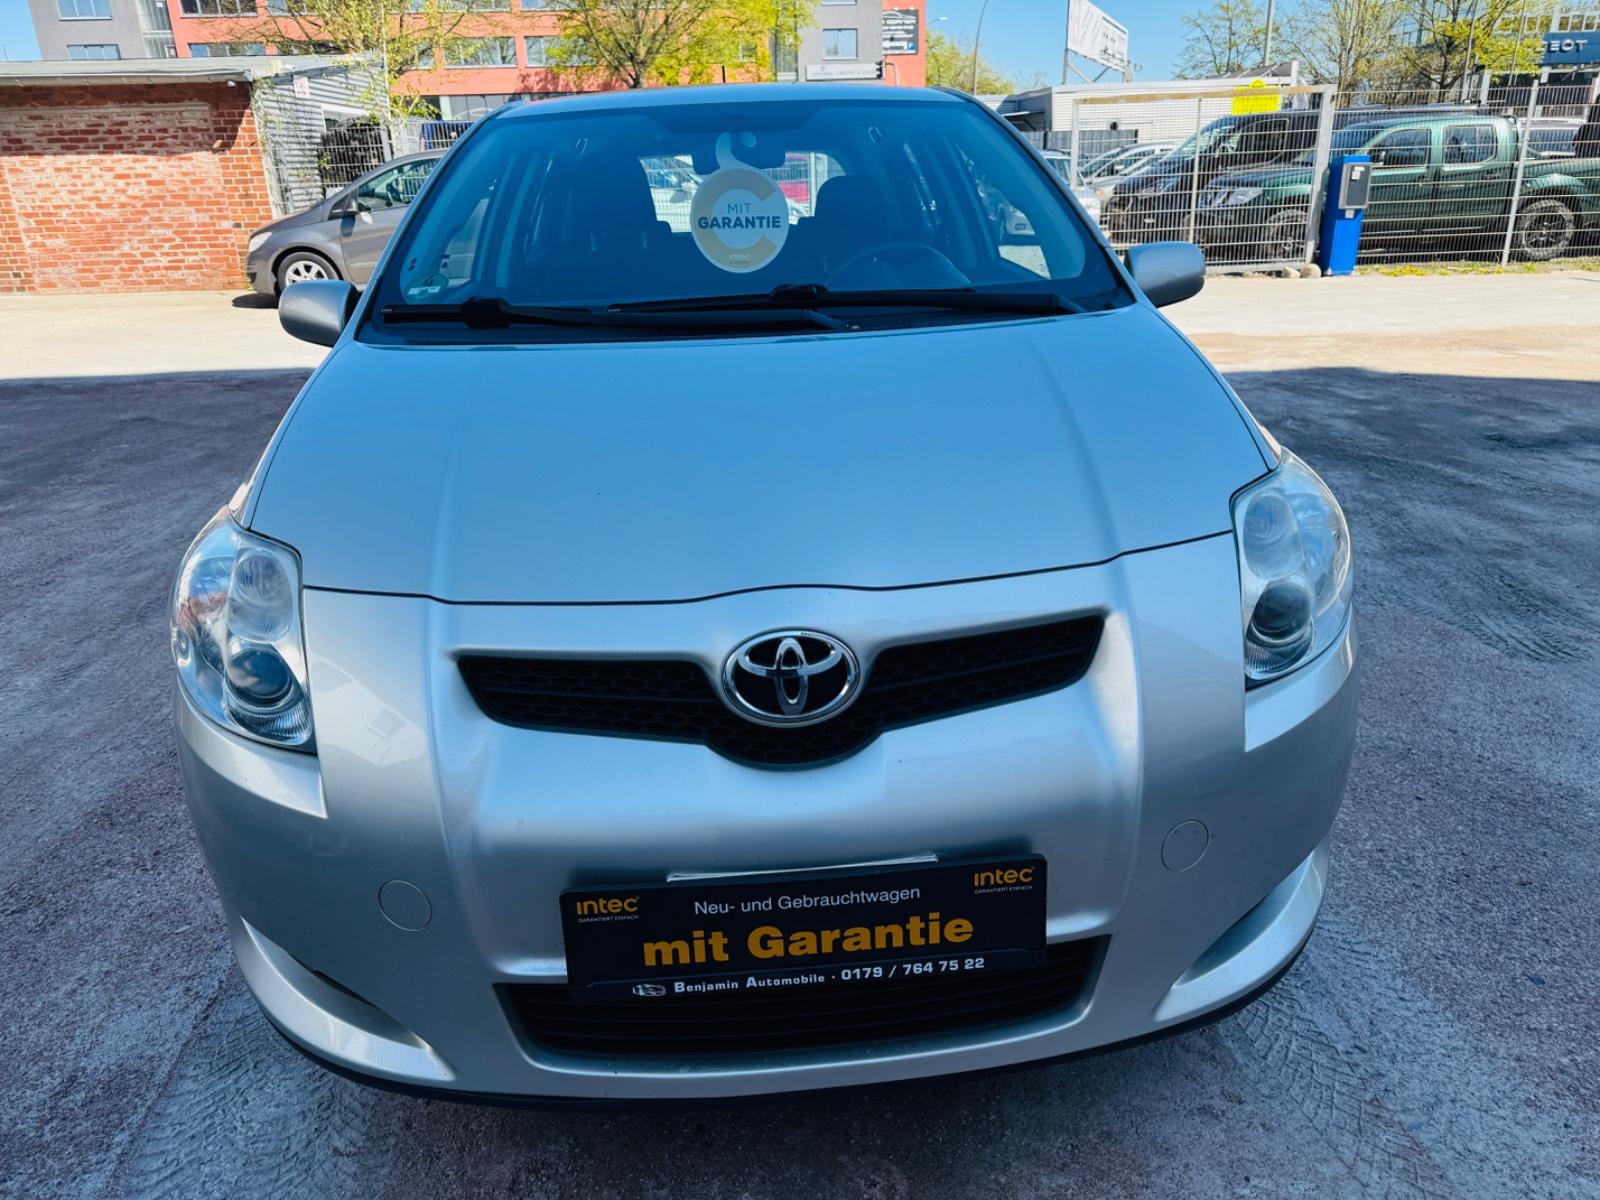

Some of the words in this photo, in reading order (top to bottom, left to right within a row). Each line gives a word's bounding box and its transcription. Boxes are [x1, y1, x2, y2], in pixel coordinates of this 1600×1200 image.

[698, 216, 781, 229] GARANTIE
[727, 203, 752, 214] MIT
[694, 901, 735, 915] Neu-
[741, 898, 772, 912] und
[778, 887, 921, 909] Gebrauchtwagen
[643, 930, 729, 967] mit
[747, 911, 974, 959] Garantie
[673, 980, 739, 994] Benjamin
[746, 973, 825, 988] Automobile
[841, 966, 883, 981] 0179
[903, 961, 934, 976] 764
[938, 959, 959, 972] 75
[964, 957, 985, 969] 22
